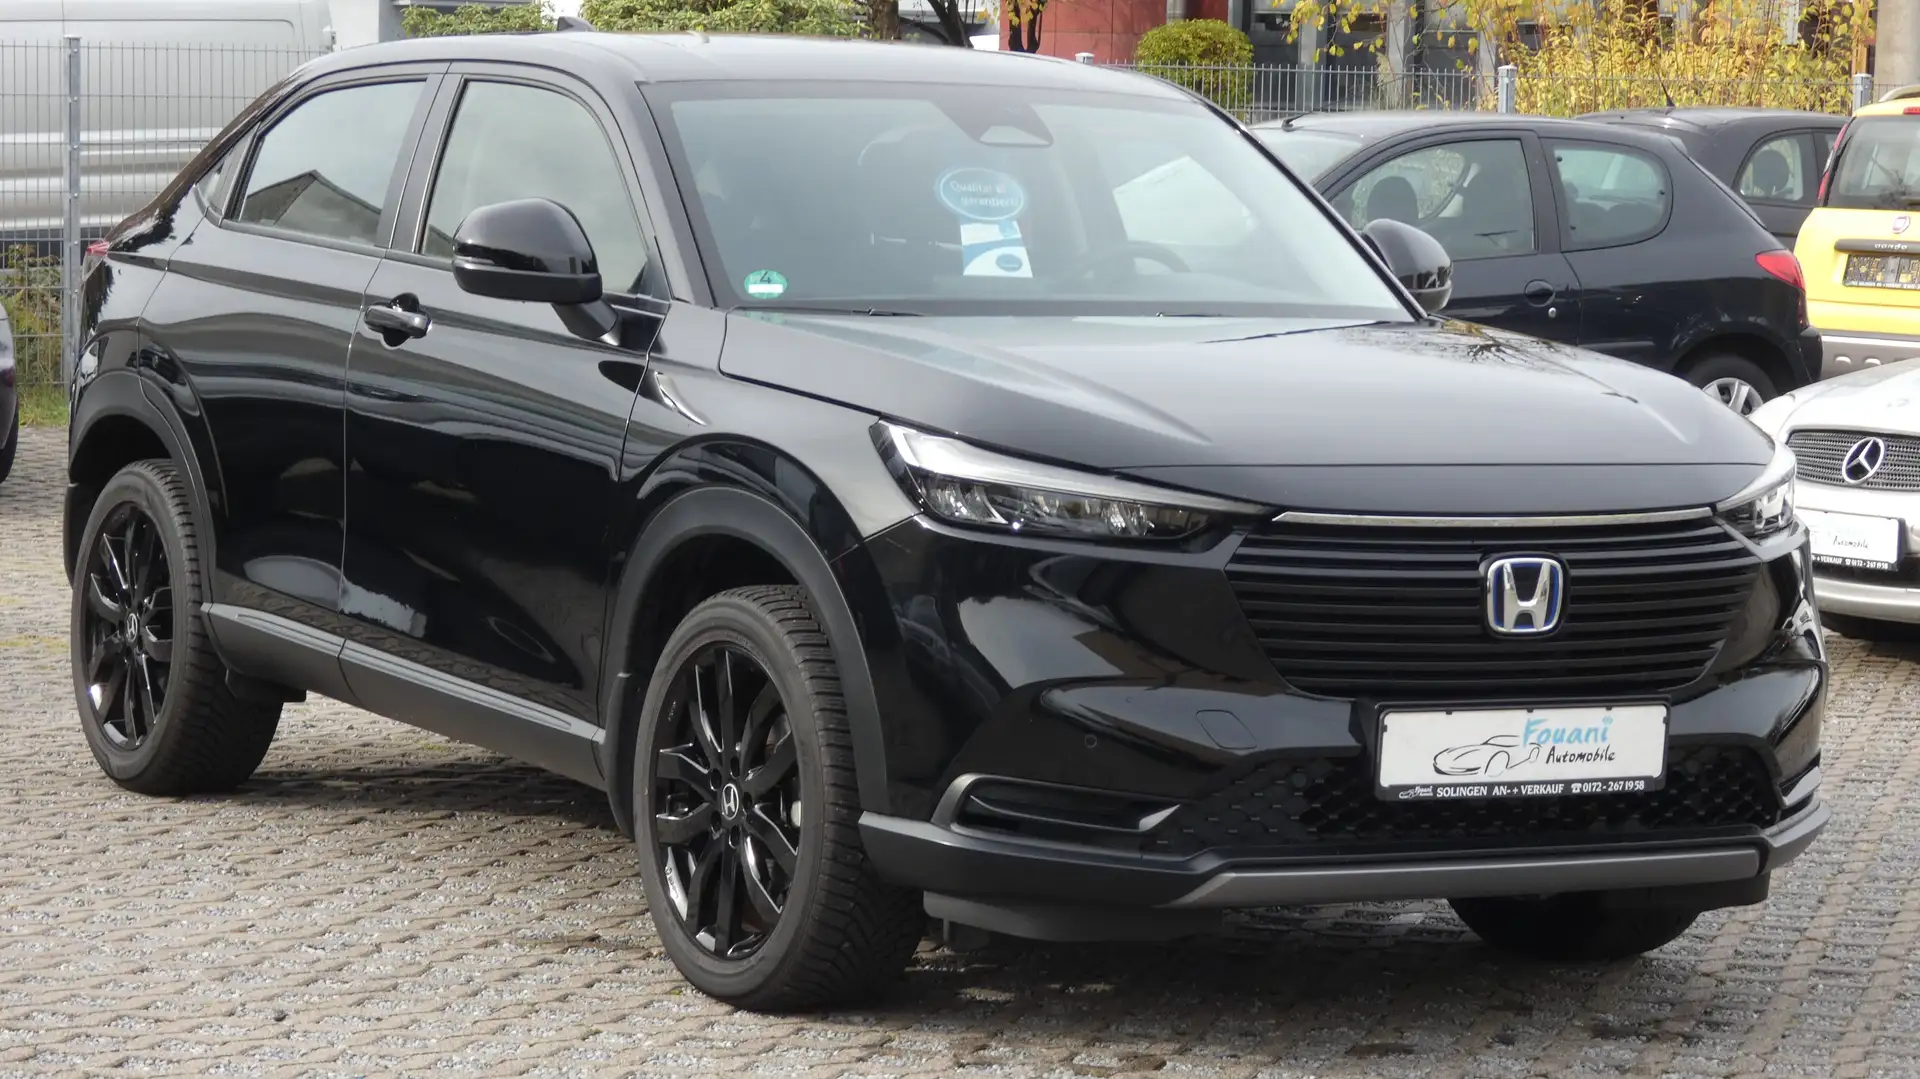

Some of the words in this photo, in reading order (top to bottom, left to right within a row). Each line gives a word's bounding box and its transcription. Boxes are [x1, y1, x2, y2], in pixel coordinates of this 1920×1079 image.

[1523, 715, 1614, 748] Fouani
[1545, 744, 1616, 764] Automobile
[1436, 786, 1488, 797] SOLINGEN
[1520, 783, 1565, 795] VERKAUF
